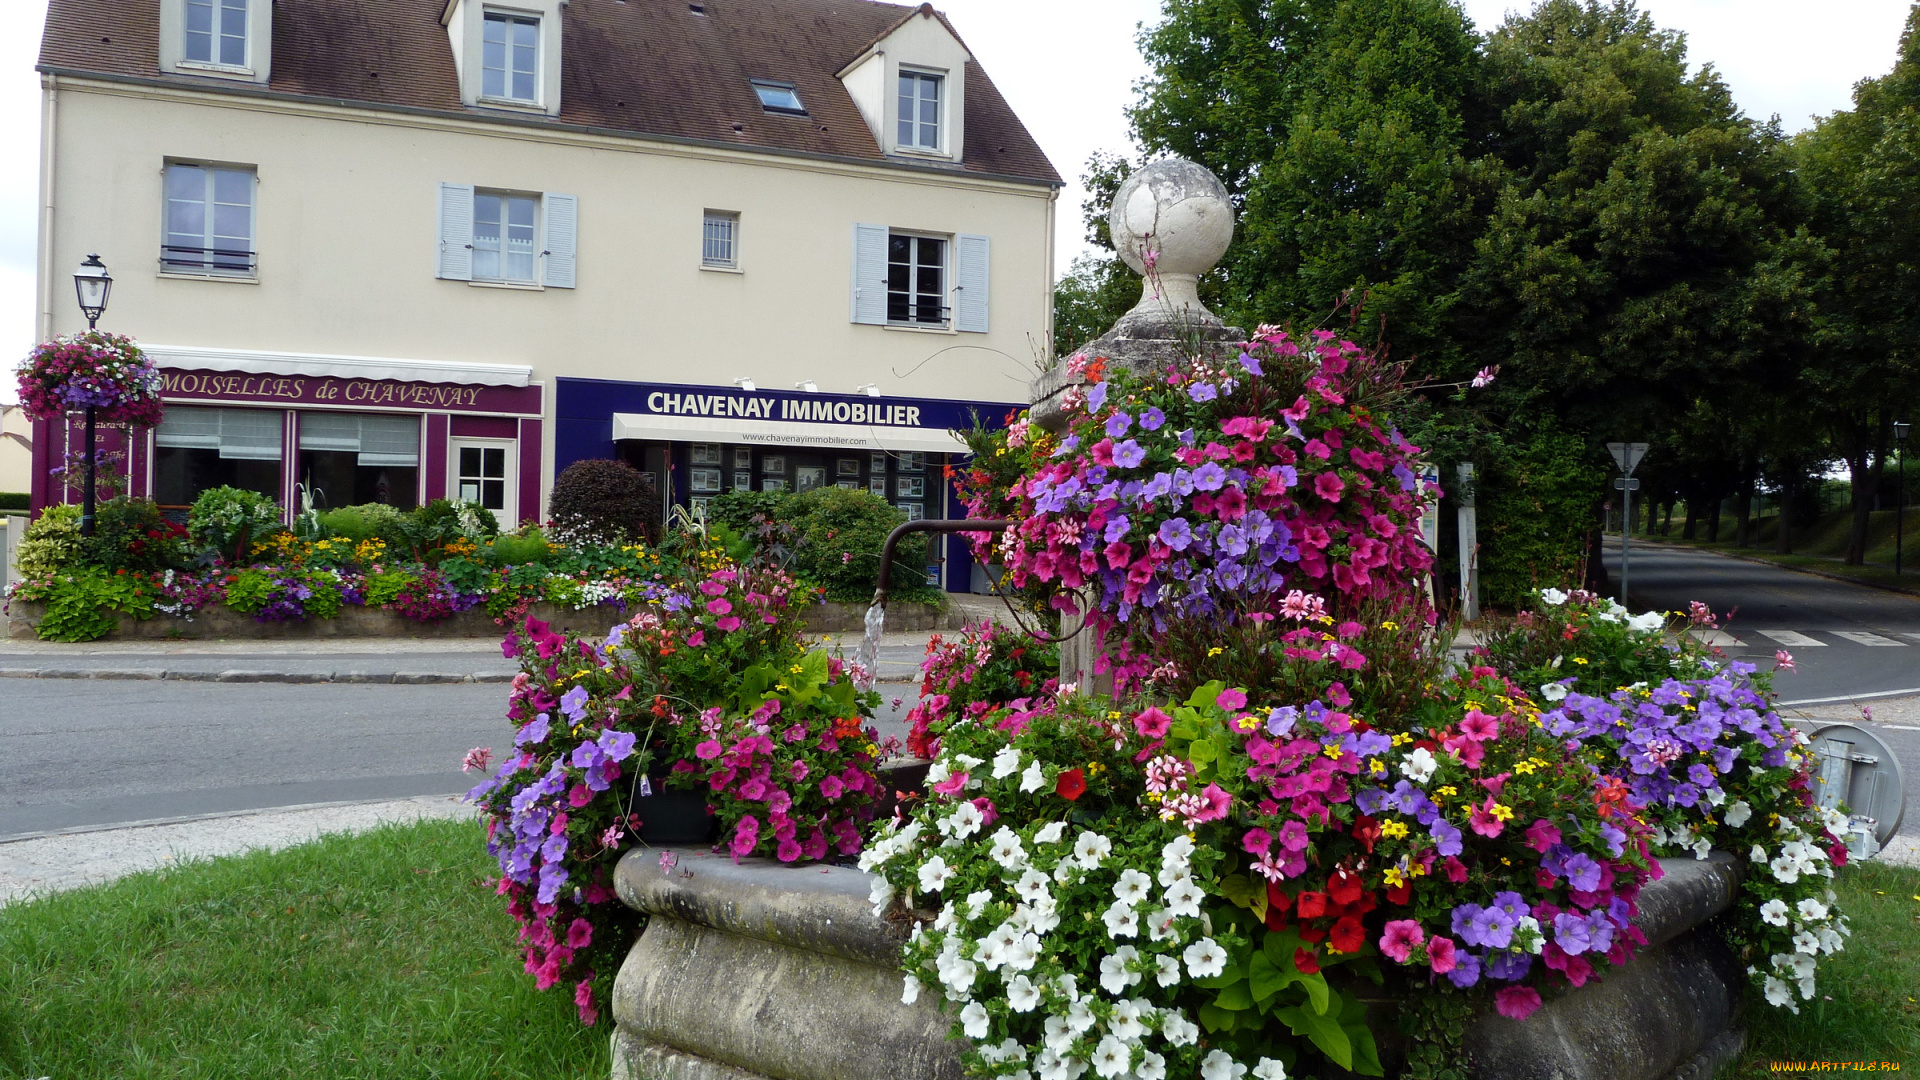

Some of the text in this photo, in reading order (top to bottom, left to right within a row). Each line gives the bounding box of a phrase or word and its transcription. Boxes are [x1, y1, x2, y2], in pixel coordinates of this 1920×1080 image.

[315, 380, 338, 399] de
[345, 381, 484, 407] CHAVENAY
[647, 391, 921, 426] CHAVENAY IMMOBILIER
[742, 433, 867, 446] www.chavenayimmobilier.com
